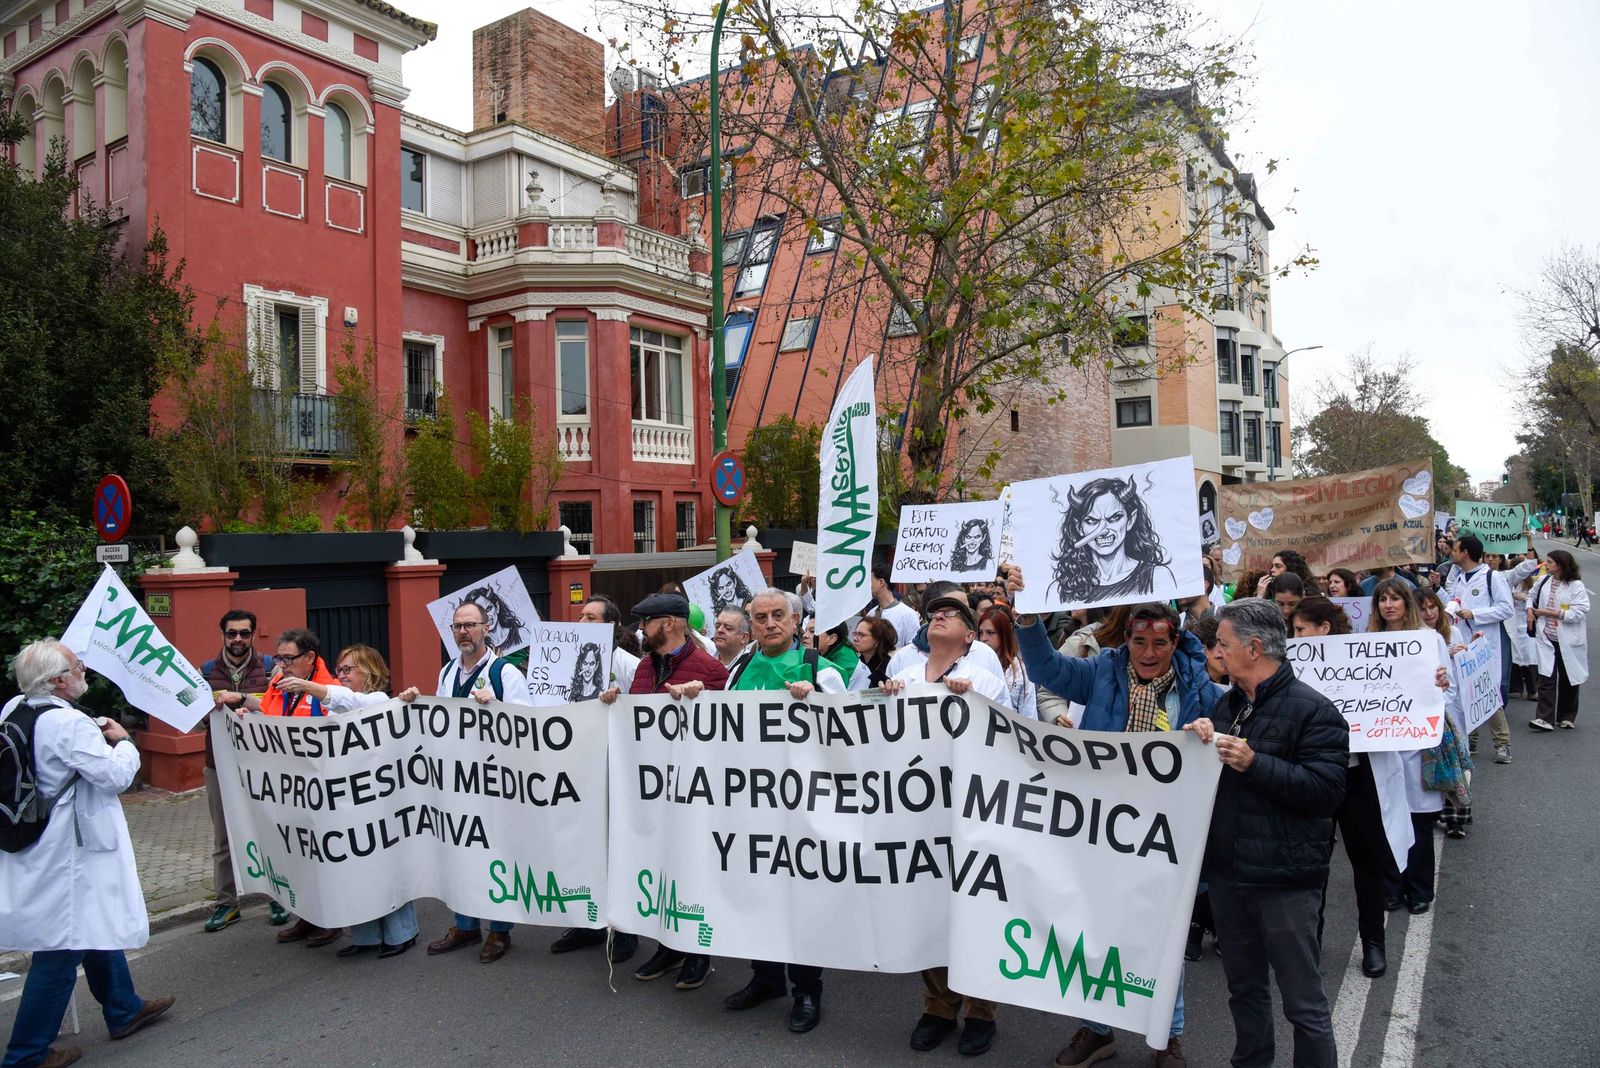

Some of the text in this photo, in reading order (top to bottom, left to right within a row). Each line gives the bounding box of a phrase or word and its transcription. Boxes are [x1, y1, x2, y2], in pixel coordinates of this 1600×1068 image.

[831, 412, 849, 491] Sevilla
[911, 509, 938, 524] ESTE
[1461, 519, 1510, 529] DE VICTIMA
[1471, 507, 1516, 517] MONICA
[902, 526, 949, 539] ESTATUTO
[1482, 533, 1522, 543] VERDUGO
[541, 646, 561, 664] NO
[1286, 640, 1422, 662] CON TALENTO
[531, 667, 550, 681] ES
[1295, 663, 1393, 681] Y VOCACIÓN
[249, 722, 287, 755] UN
[286, 703, 449, 758] ESTATUTO
[459, 706, 574, 752] PROPIO
[1375, 716, 1412, 726] HORA
[633, 703, 689, 742] POR
[693, 702, 744, 743] UN
[759, 694, 971, 747] ESTATUTO
[984, 704, 1183, 784] PROPIO
[246, 768, 277, 803] LA
[280, 745, 444, 811] PROFESIÓN
[454, 754, 581, 807] MÉDICA
[276, 804, 490, 863] Y FACULTATIVA
[962, 771, 1179, 865] MÉDICA
[712, 831, 736, 872] Y
[489, 859, 591, 915] SMA Sevilla
[637, 868, 705, 933] SMA Sevilla
[999, 917, 1126, 1008] SMA
